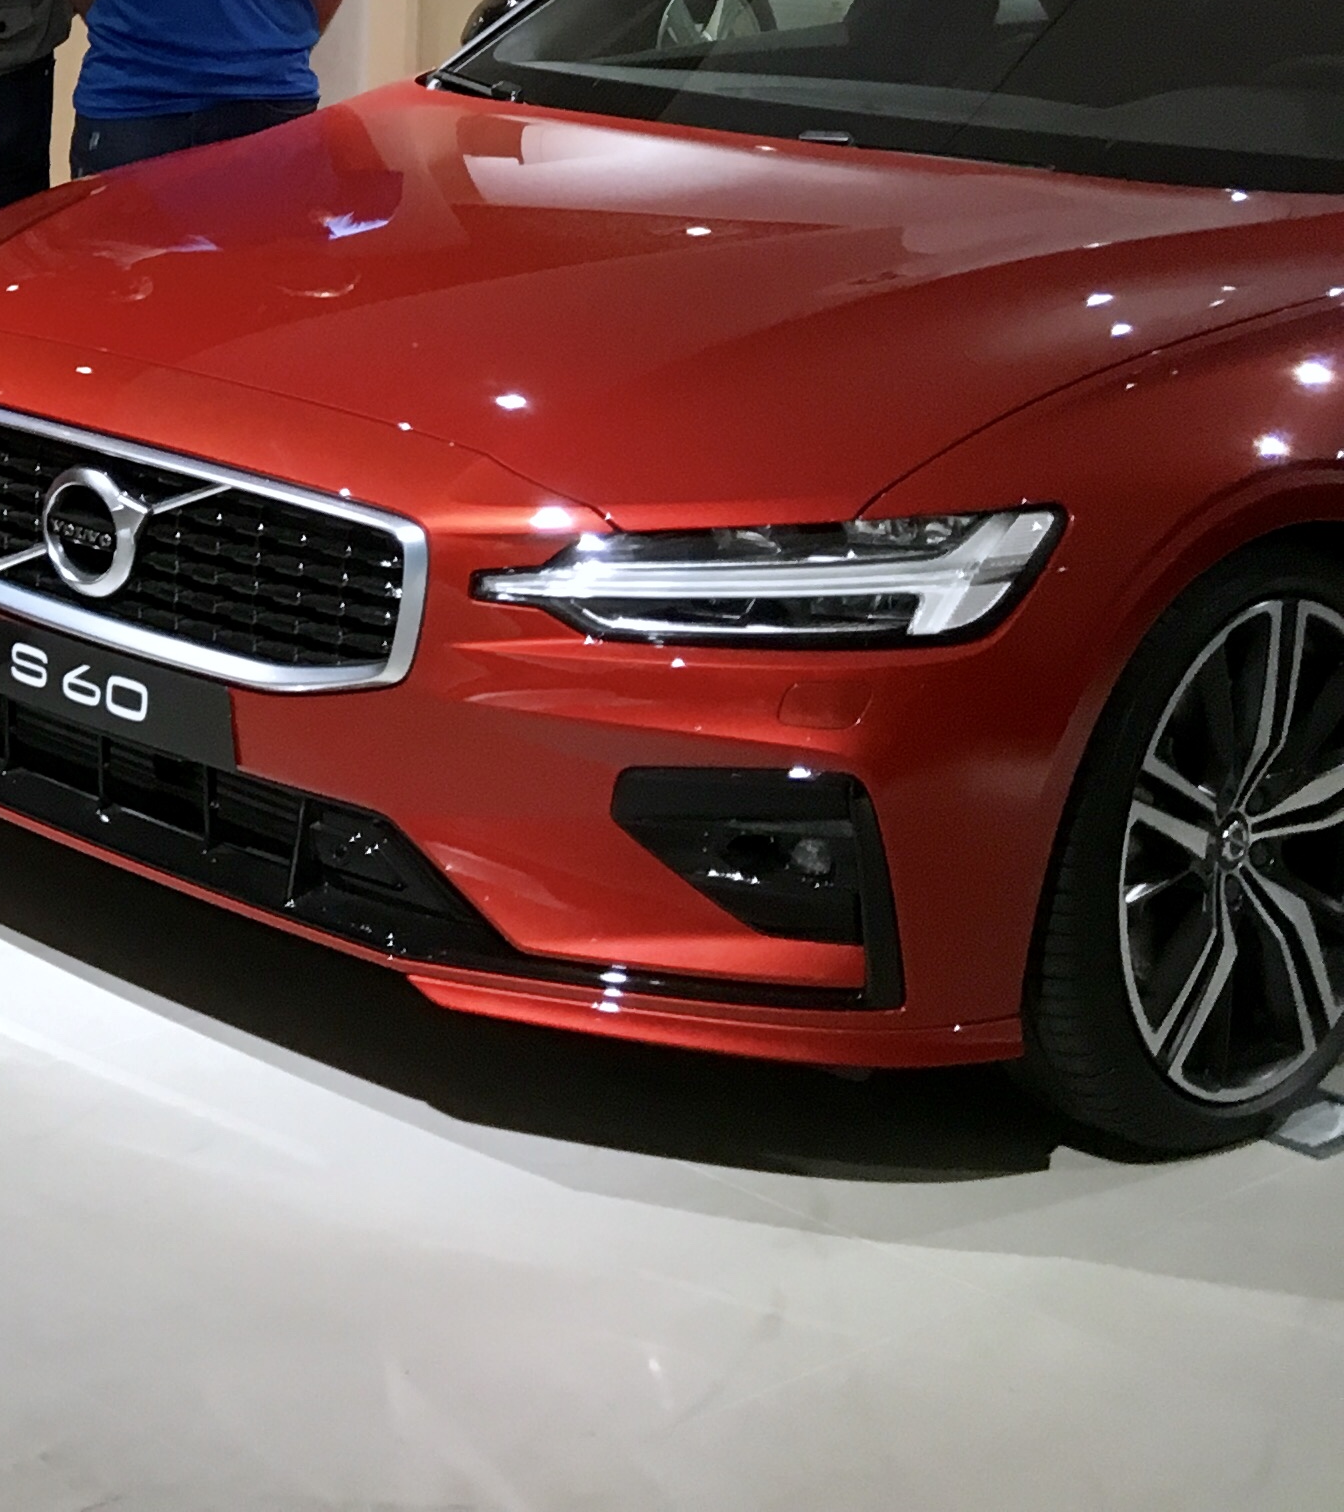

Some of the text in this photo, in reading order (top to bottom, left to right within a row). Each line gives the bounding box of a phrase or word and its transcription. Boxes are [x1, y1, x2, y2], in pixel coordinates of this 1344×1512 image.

[50, 518, 112, 547] VOLVO
[11, 642, 148, 722] S 60
